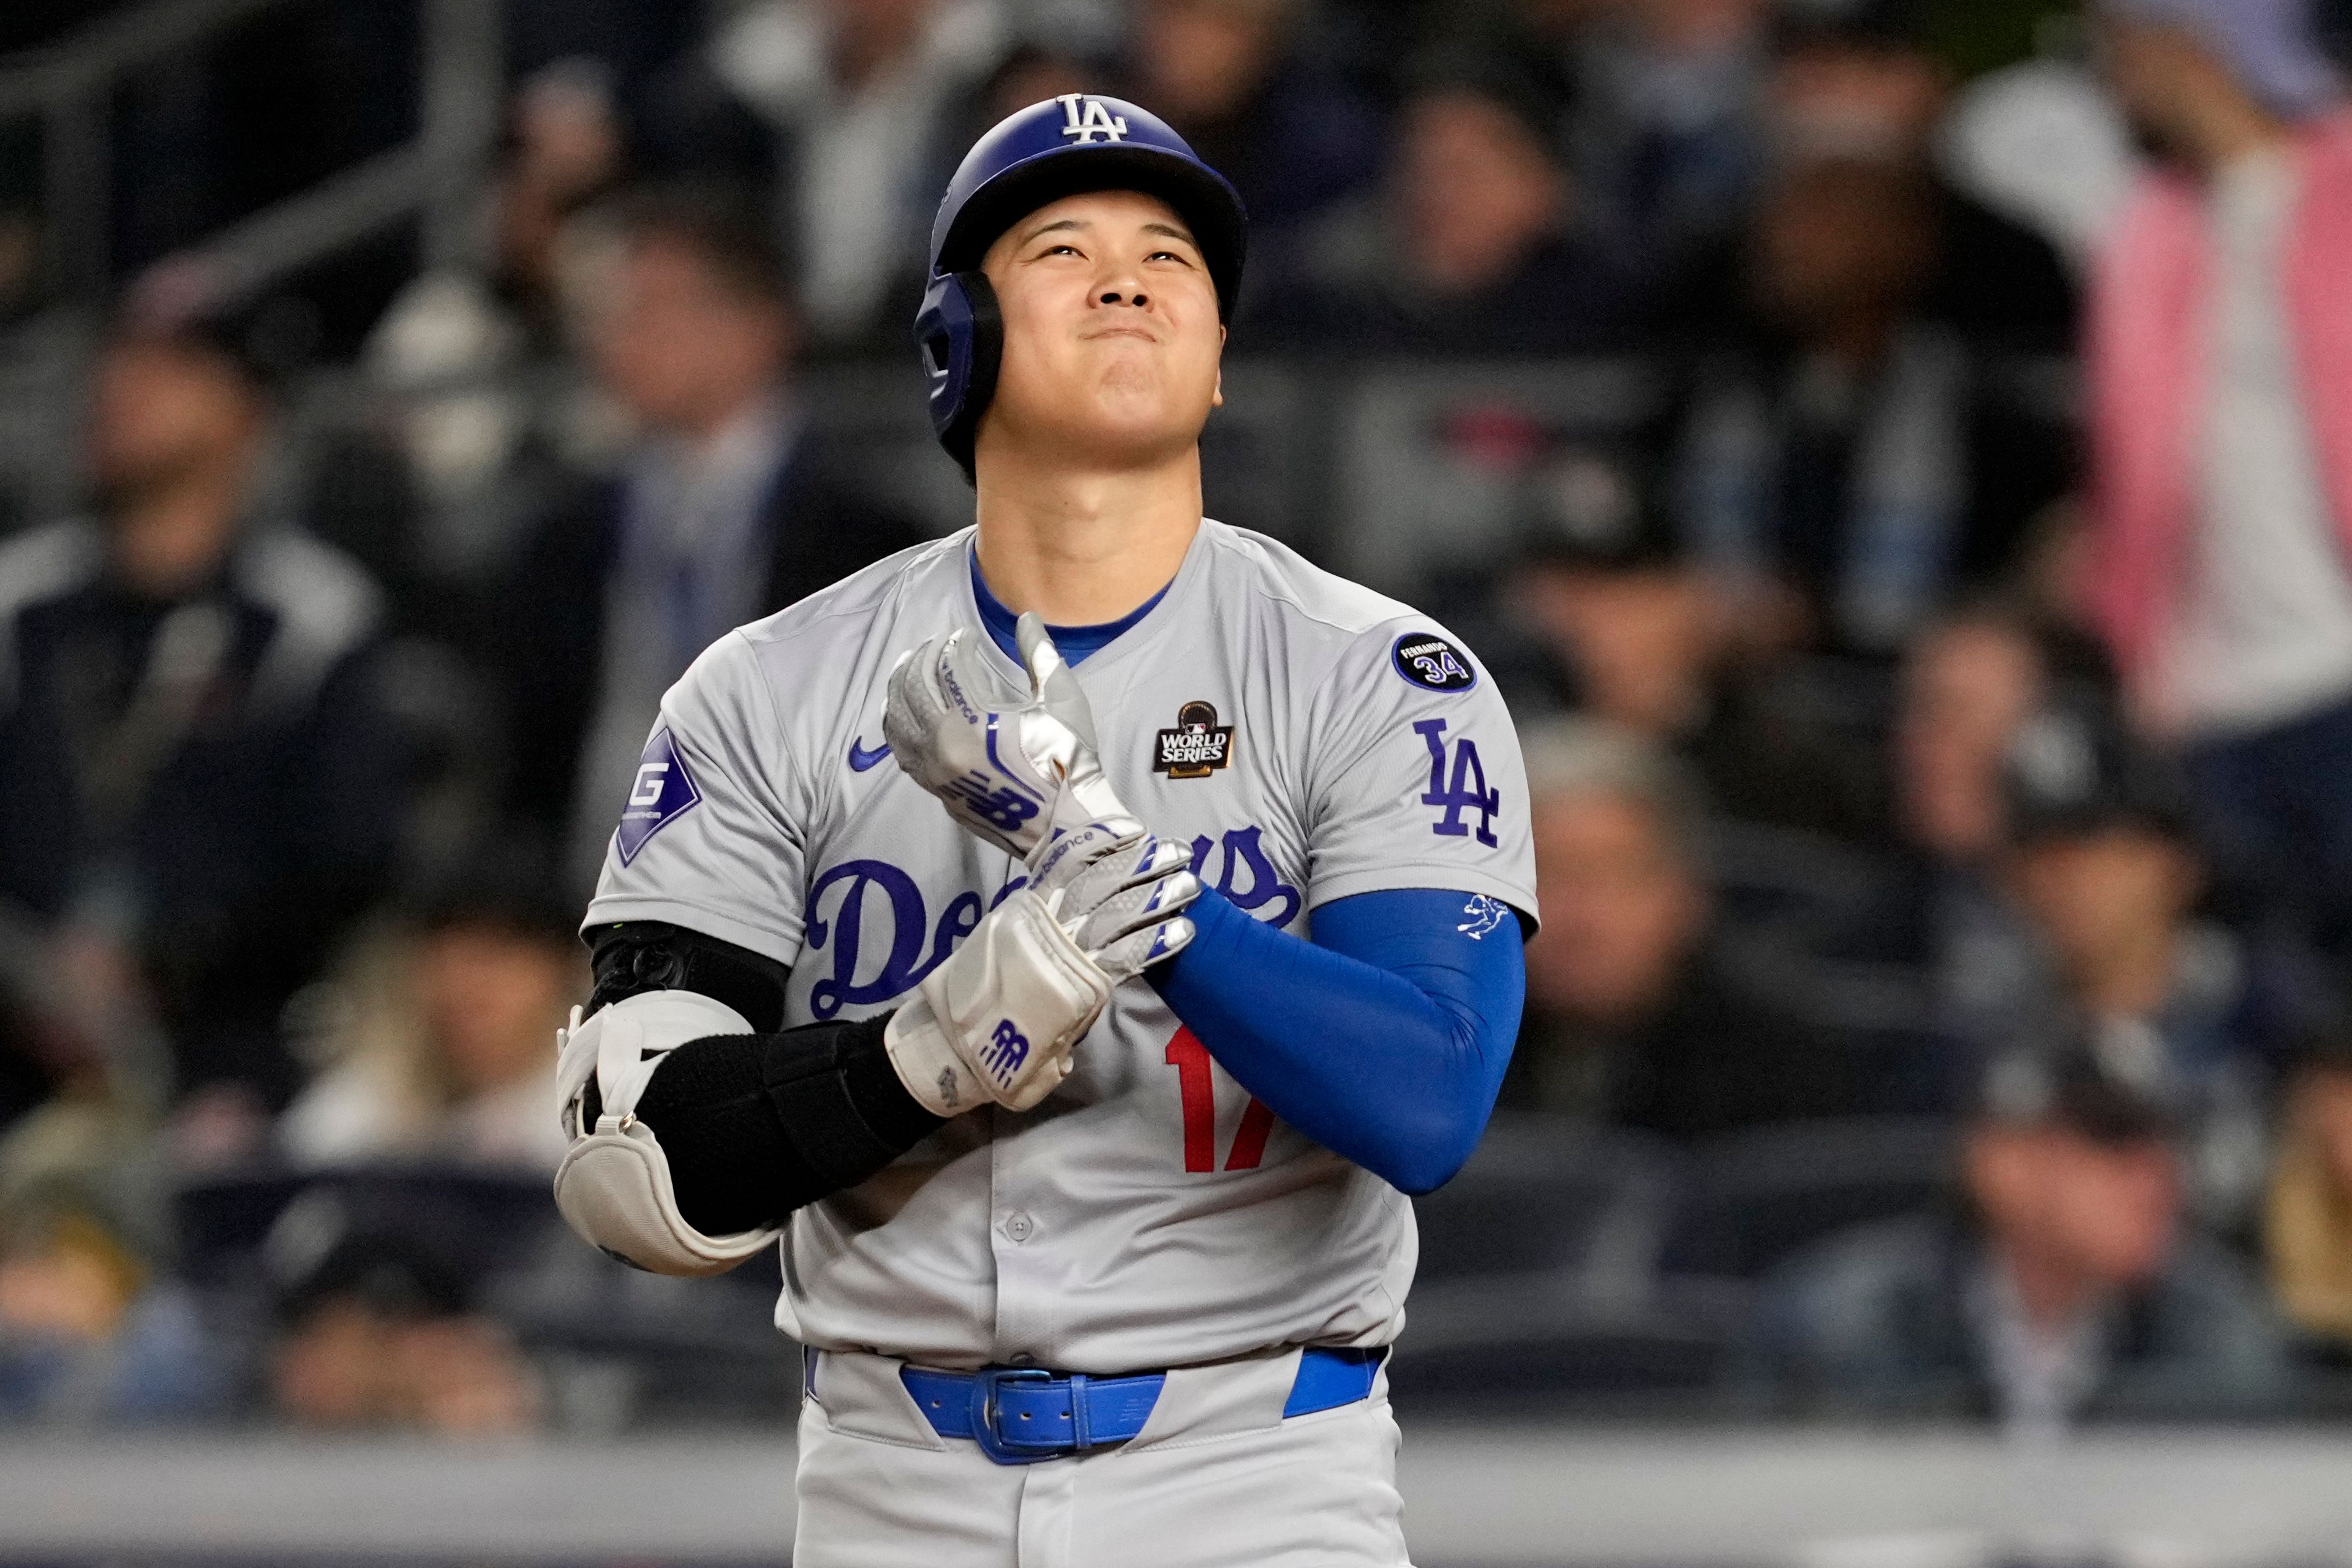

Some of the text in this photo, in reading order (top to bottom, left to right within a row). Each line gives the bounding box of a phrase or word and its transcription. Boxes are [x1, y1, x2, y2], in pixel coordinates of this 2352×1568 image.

[1056, 93, 1127, 145] LA
[1400, 642, 1448, 659] FERNANDO
[1414, 651, 1469, 684] 34
[1161, 733, 1227, 749] WORLD
[1161, 745, 1223, 763] SERIES
[629, 763, 669, 806] G
[1412, 718, 1499, 849] LA
